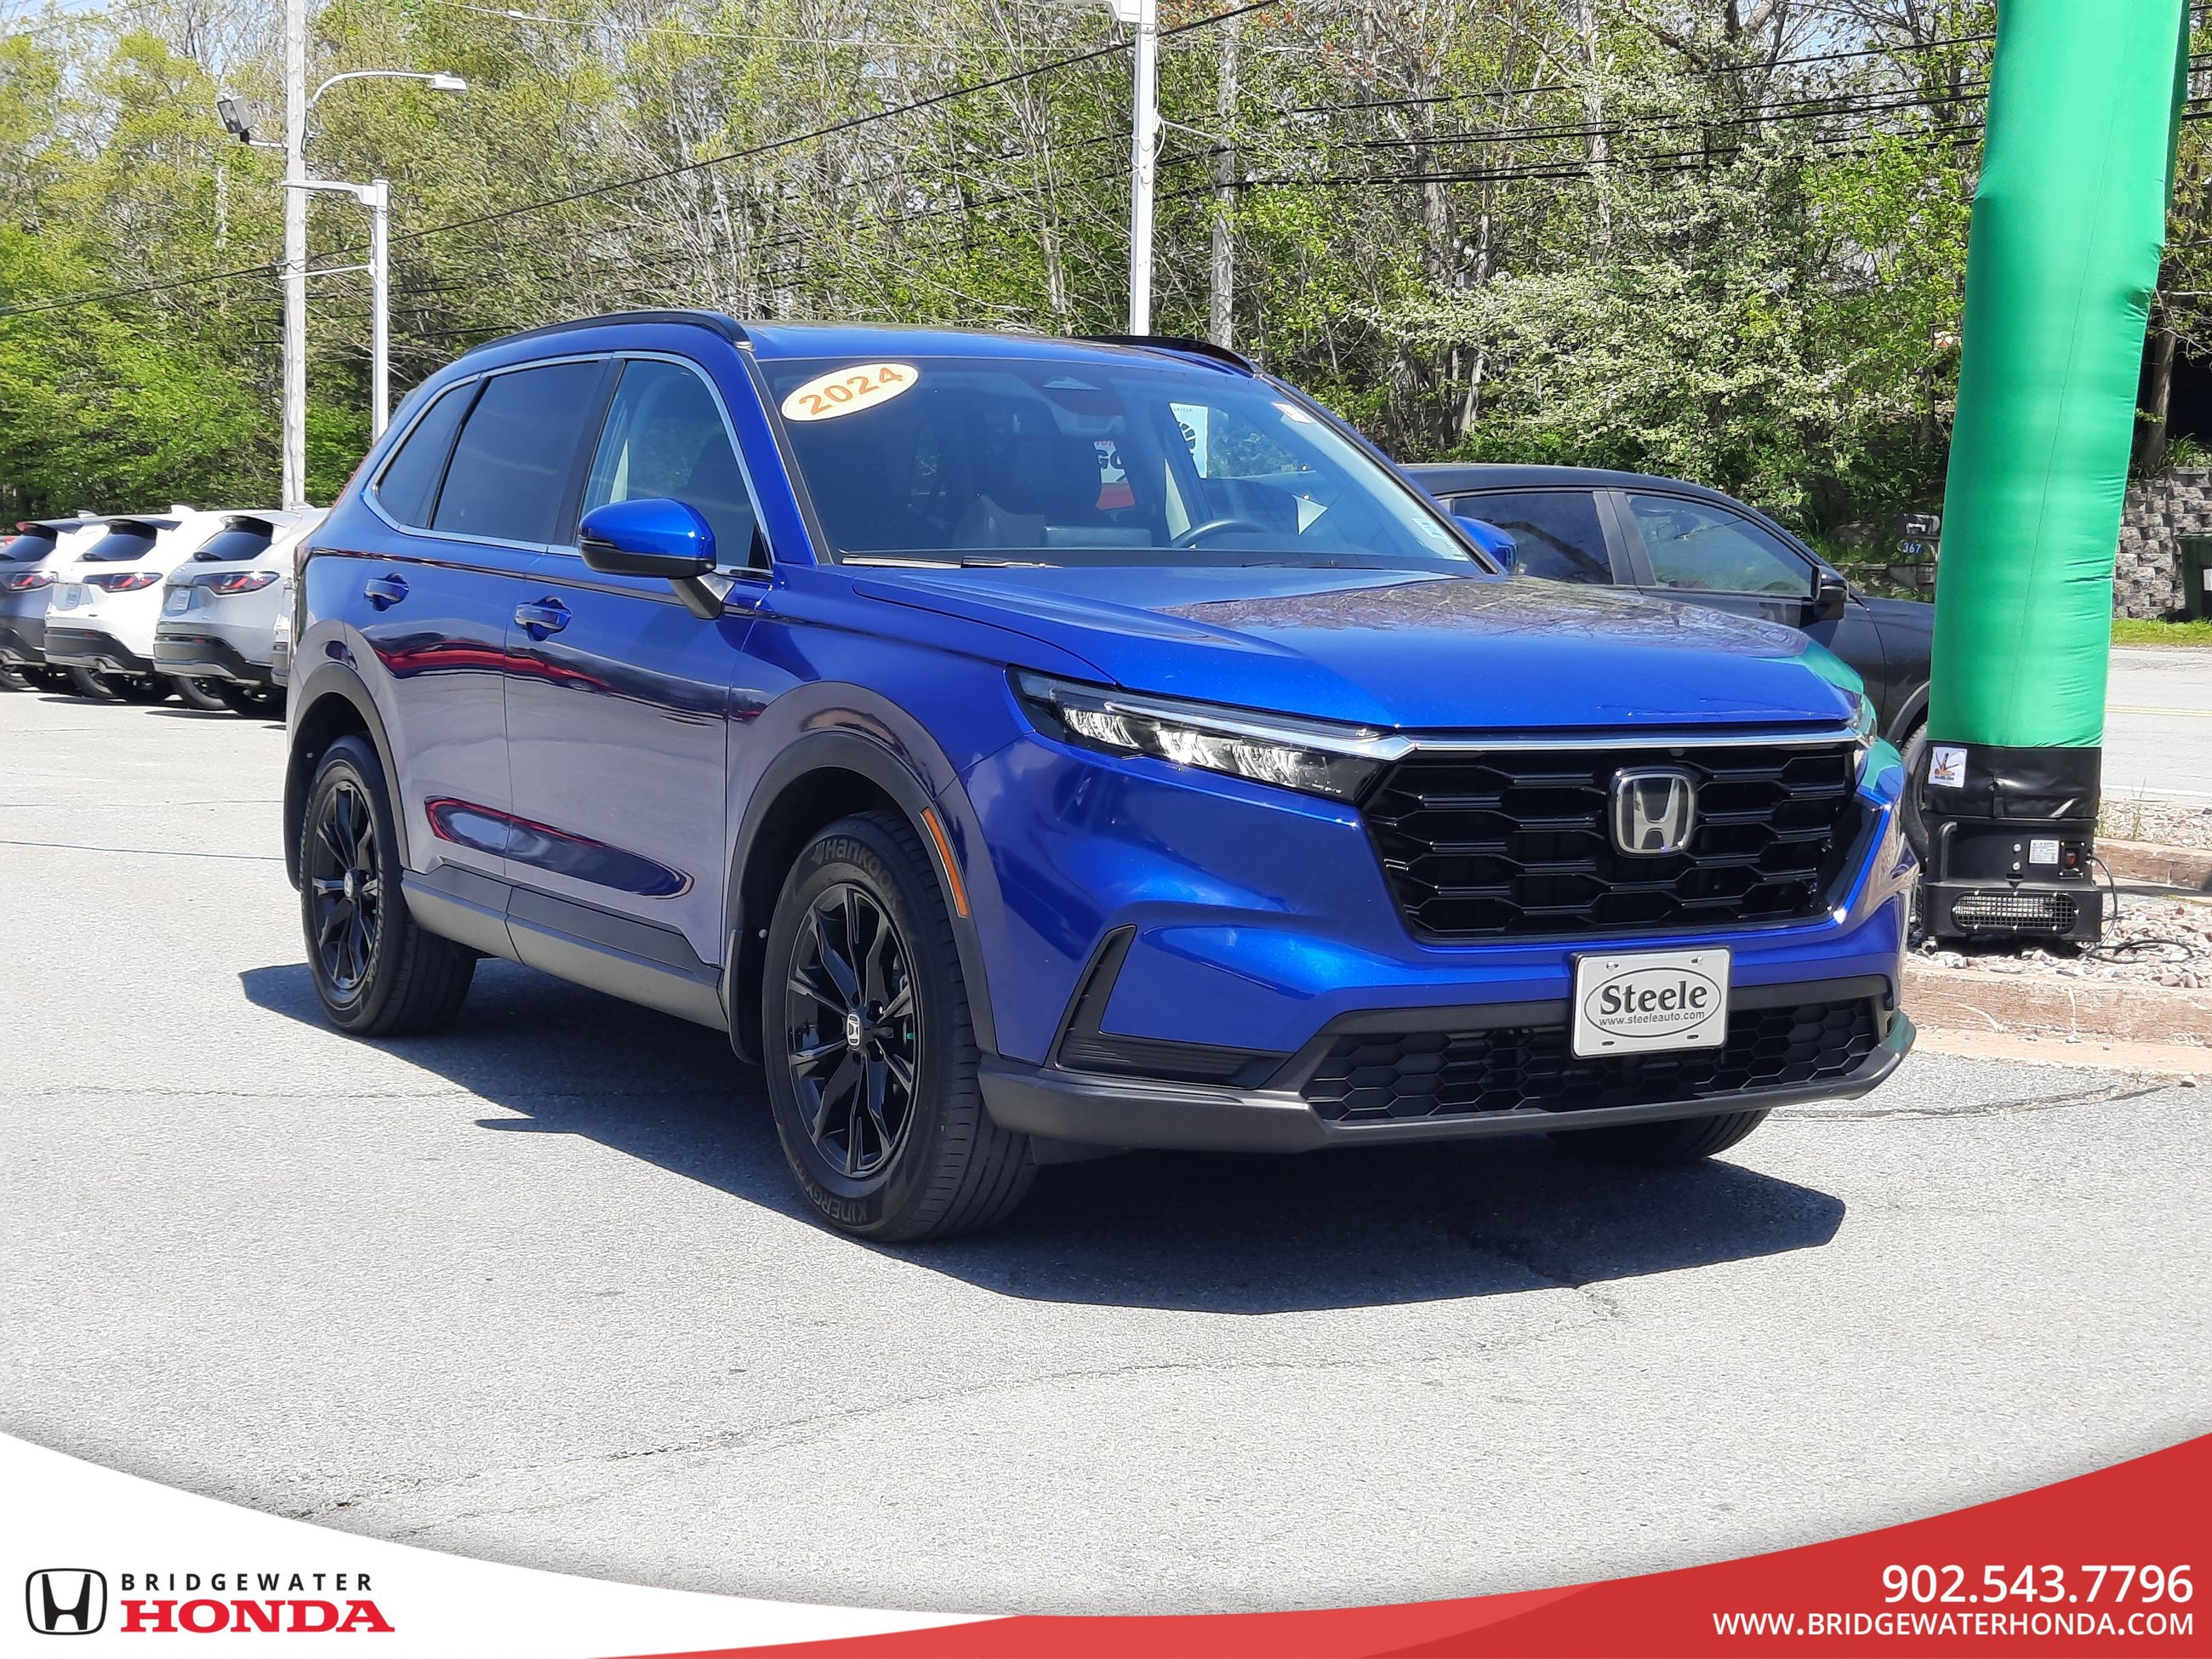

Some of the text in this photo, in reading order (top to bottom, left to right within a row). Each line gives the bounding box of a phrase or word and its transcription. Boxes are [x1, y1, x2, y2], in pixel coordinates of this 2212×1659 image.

[798, 367, 904, 415] 2024
[1902, 542, 1921, 554] 367
[1599, 979, 1708, 1016] Steele
[1599, 1010, 1706, 1027] www.steeleauto.com
